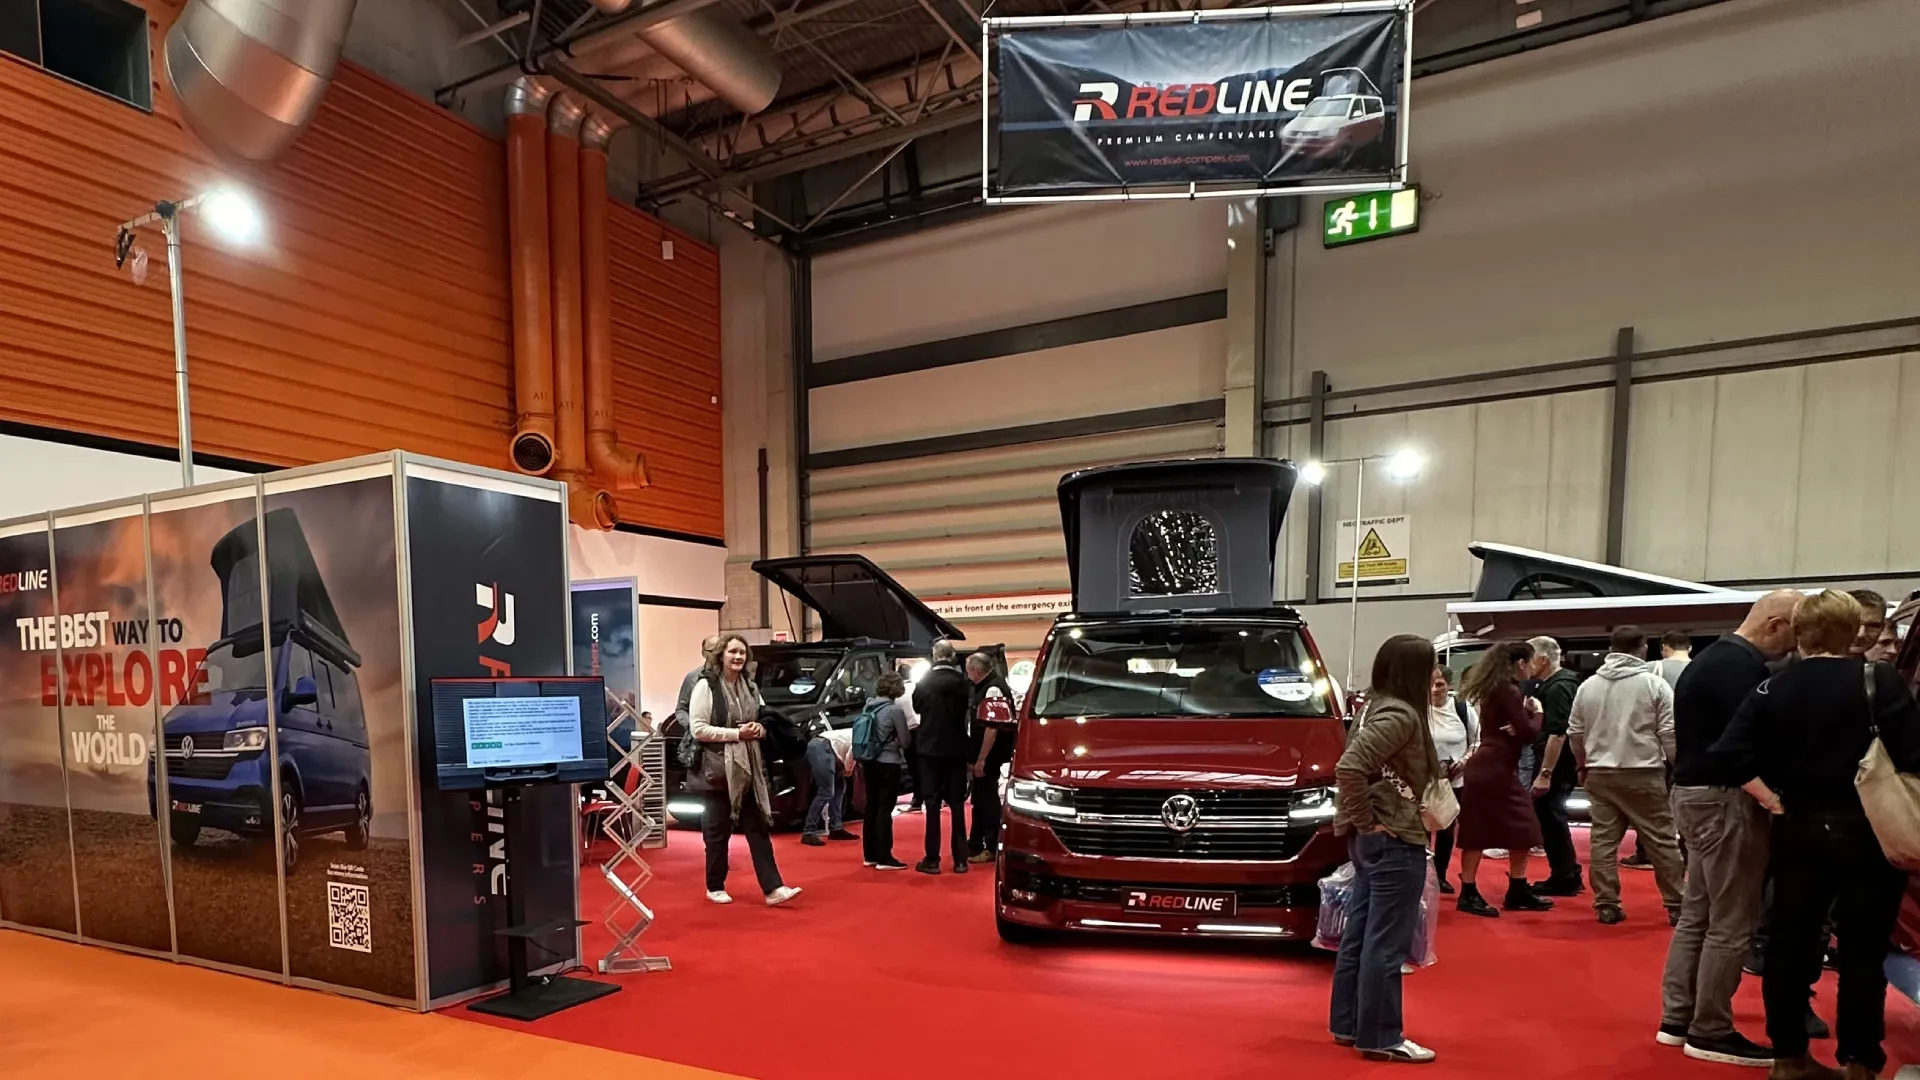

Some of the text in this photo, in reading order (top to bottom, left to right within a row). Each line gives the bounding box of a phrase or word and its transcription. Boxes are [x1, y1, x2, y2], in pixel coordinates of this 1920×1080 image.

[1126, 78, 1313, 120] REDLINE
[1097, 130, 1277, 146] PREMIUM CAMPERVANS
[965, 604, 983, 612] front
[986, 603, 994, 611] of
[996, 602, 1008, 610] the
[1011, 602, 1056, 610] emergency
[16, 611, 183, 651] THE BEST WAY TO
[41, 647, 212, 707] EXPLORE
[96, 715, 116, 730] THE
[71, 731, 146, 765] WORLD
[1149, 895, 1225, 911] REDLINE
